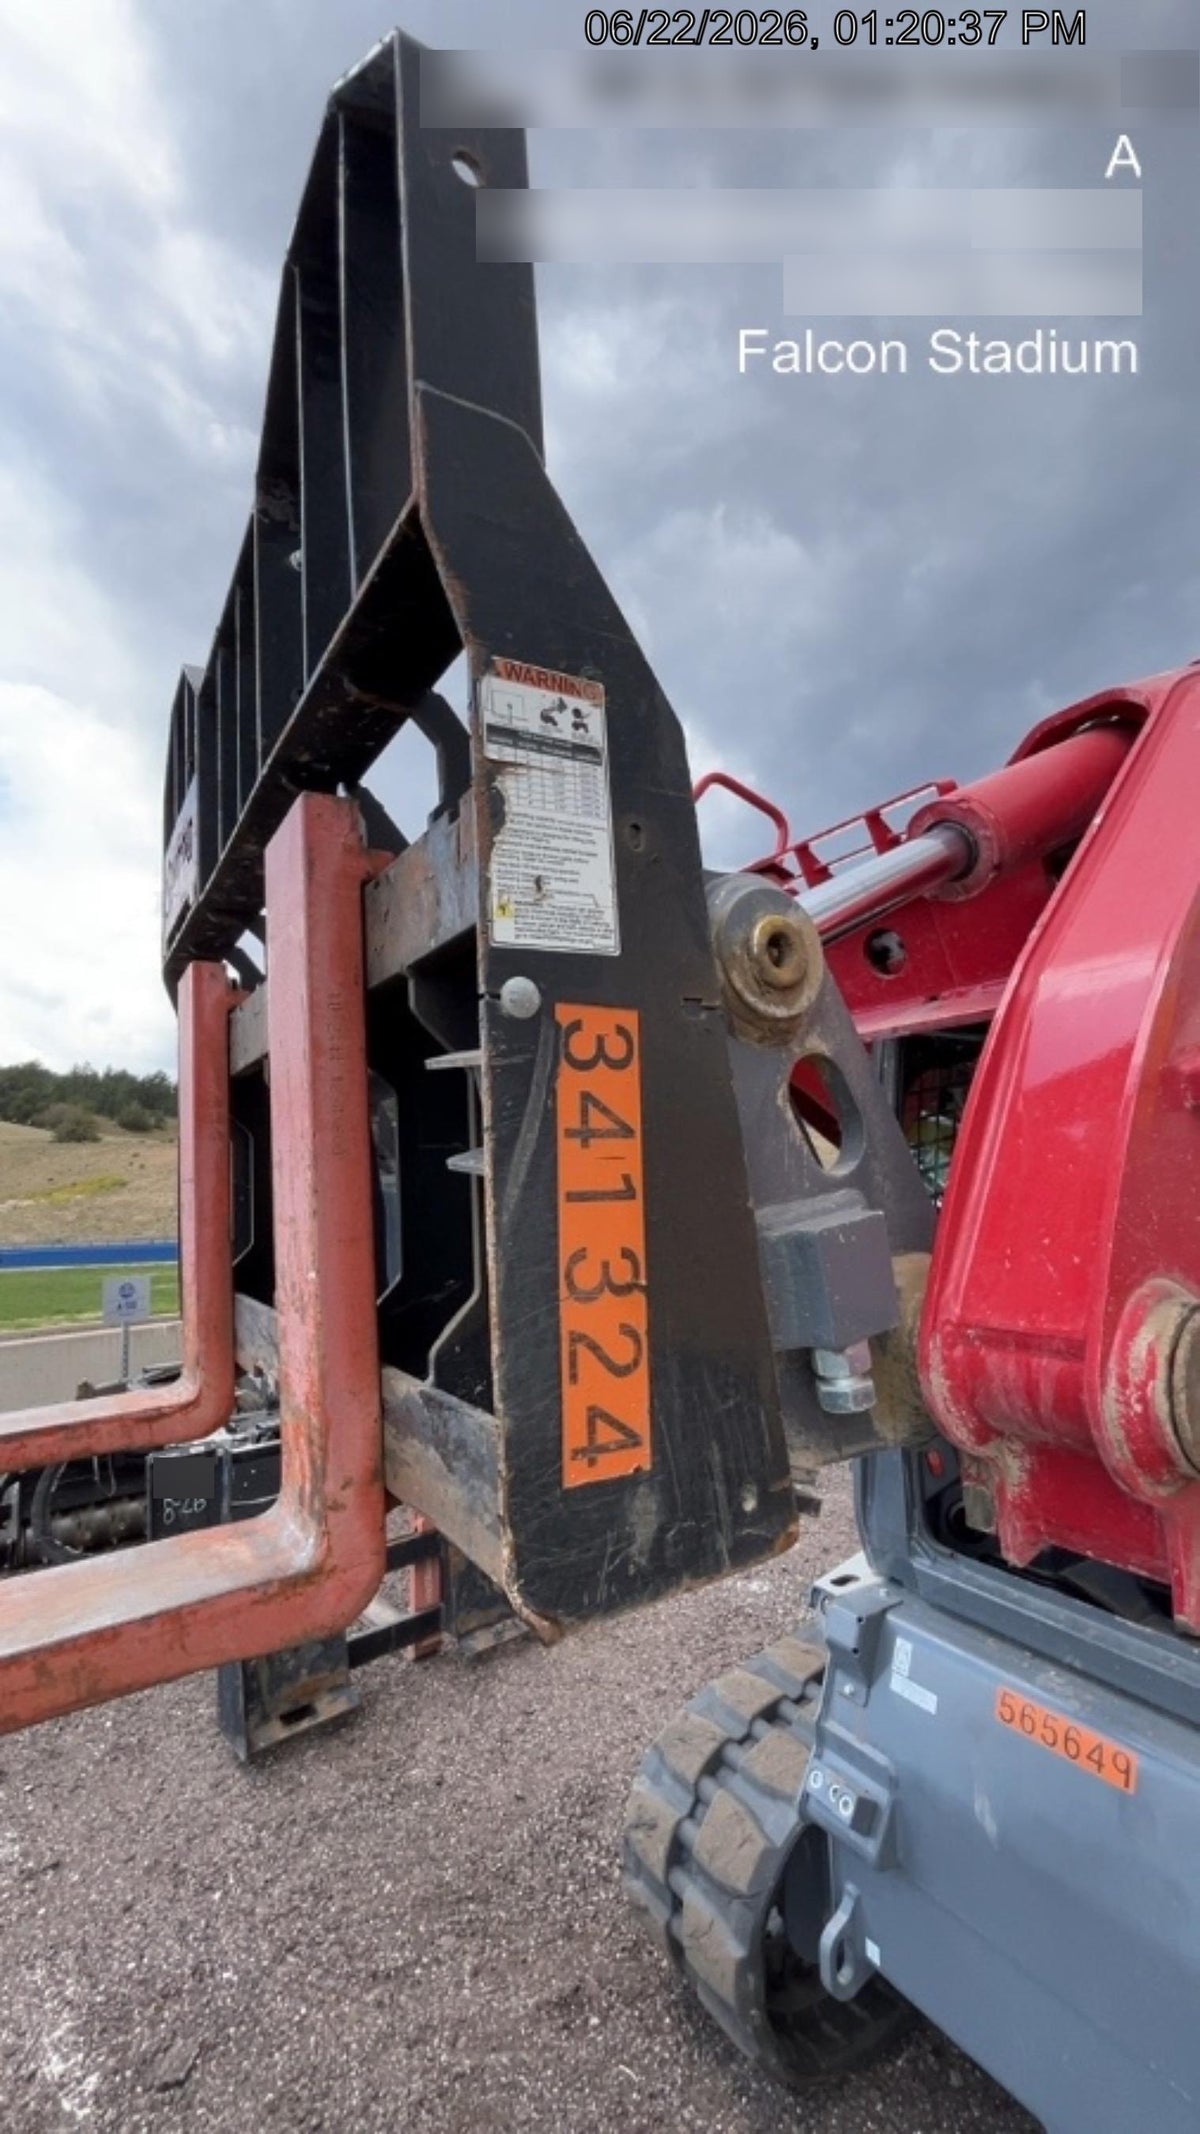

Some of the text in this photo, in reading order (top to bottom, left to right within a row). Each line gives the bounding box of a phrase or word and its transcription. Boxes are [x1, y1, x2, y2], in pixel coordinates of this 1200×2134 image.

[503, 661, 600, 701] WARNING
[562, 1018, 645, 1468] 341324
[998, 1690, 1131, 1789] 565649
